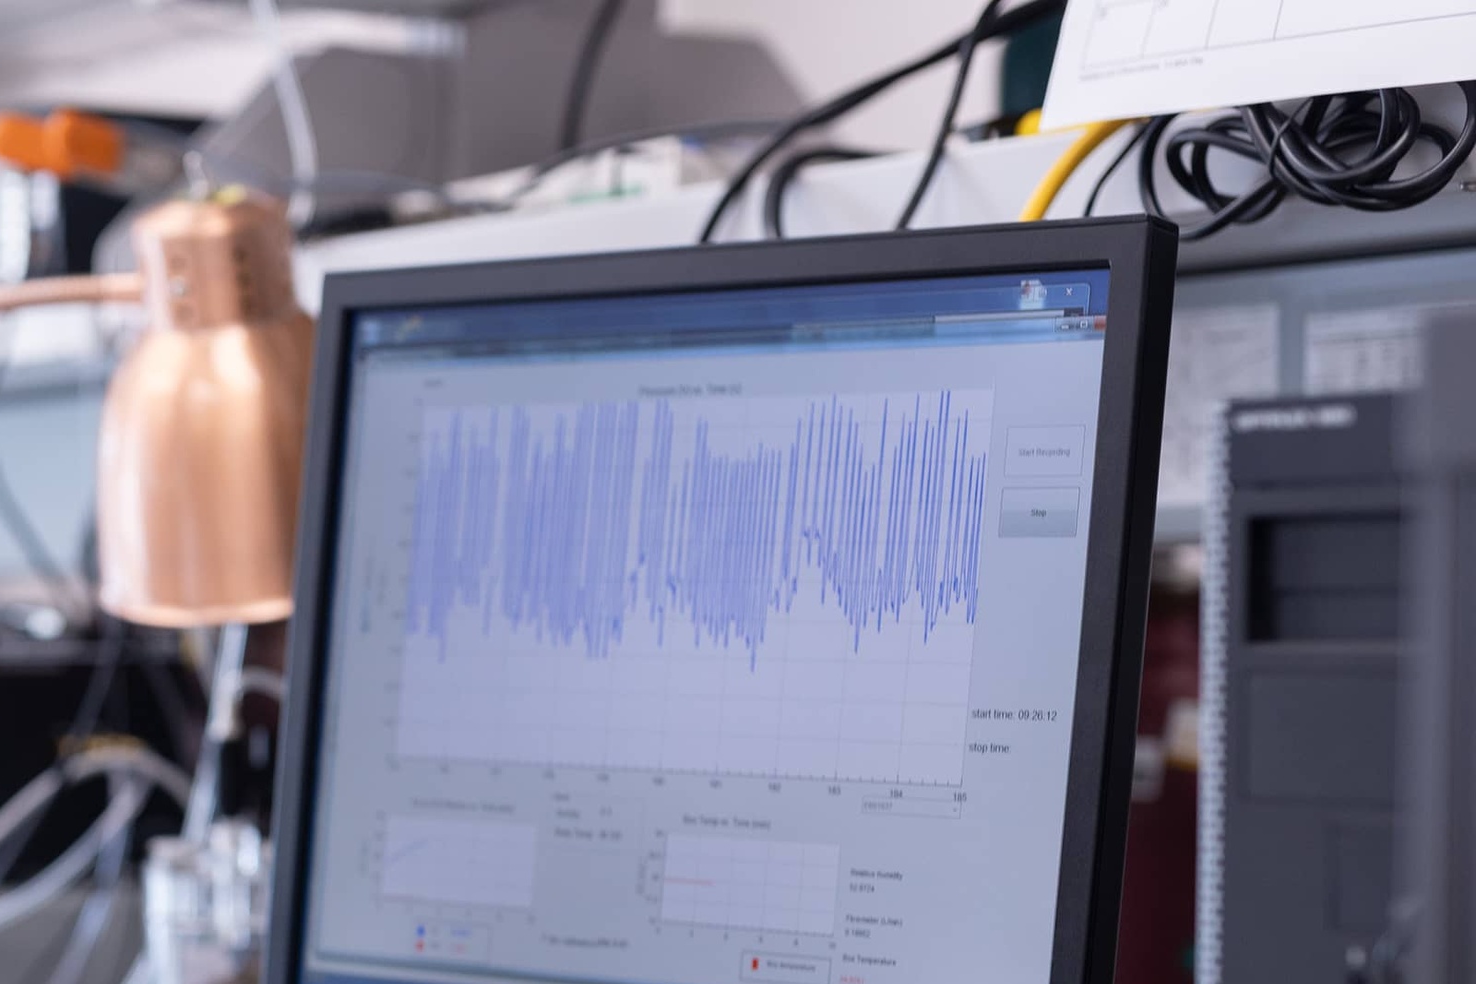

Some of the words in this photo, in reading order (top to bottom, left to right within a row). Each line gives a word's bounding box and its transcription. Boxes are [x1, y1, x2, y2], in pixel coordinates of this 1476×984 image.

[1031, 508, 1047, 518] Stop
[972, 708, 992, 720] start
[969, 743, 988, 755] stop
[953, 792, 967, 803] 185
